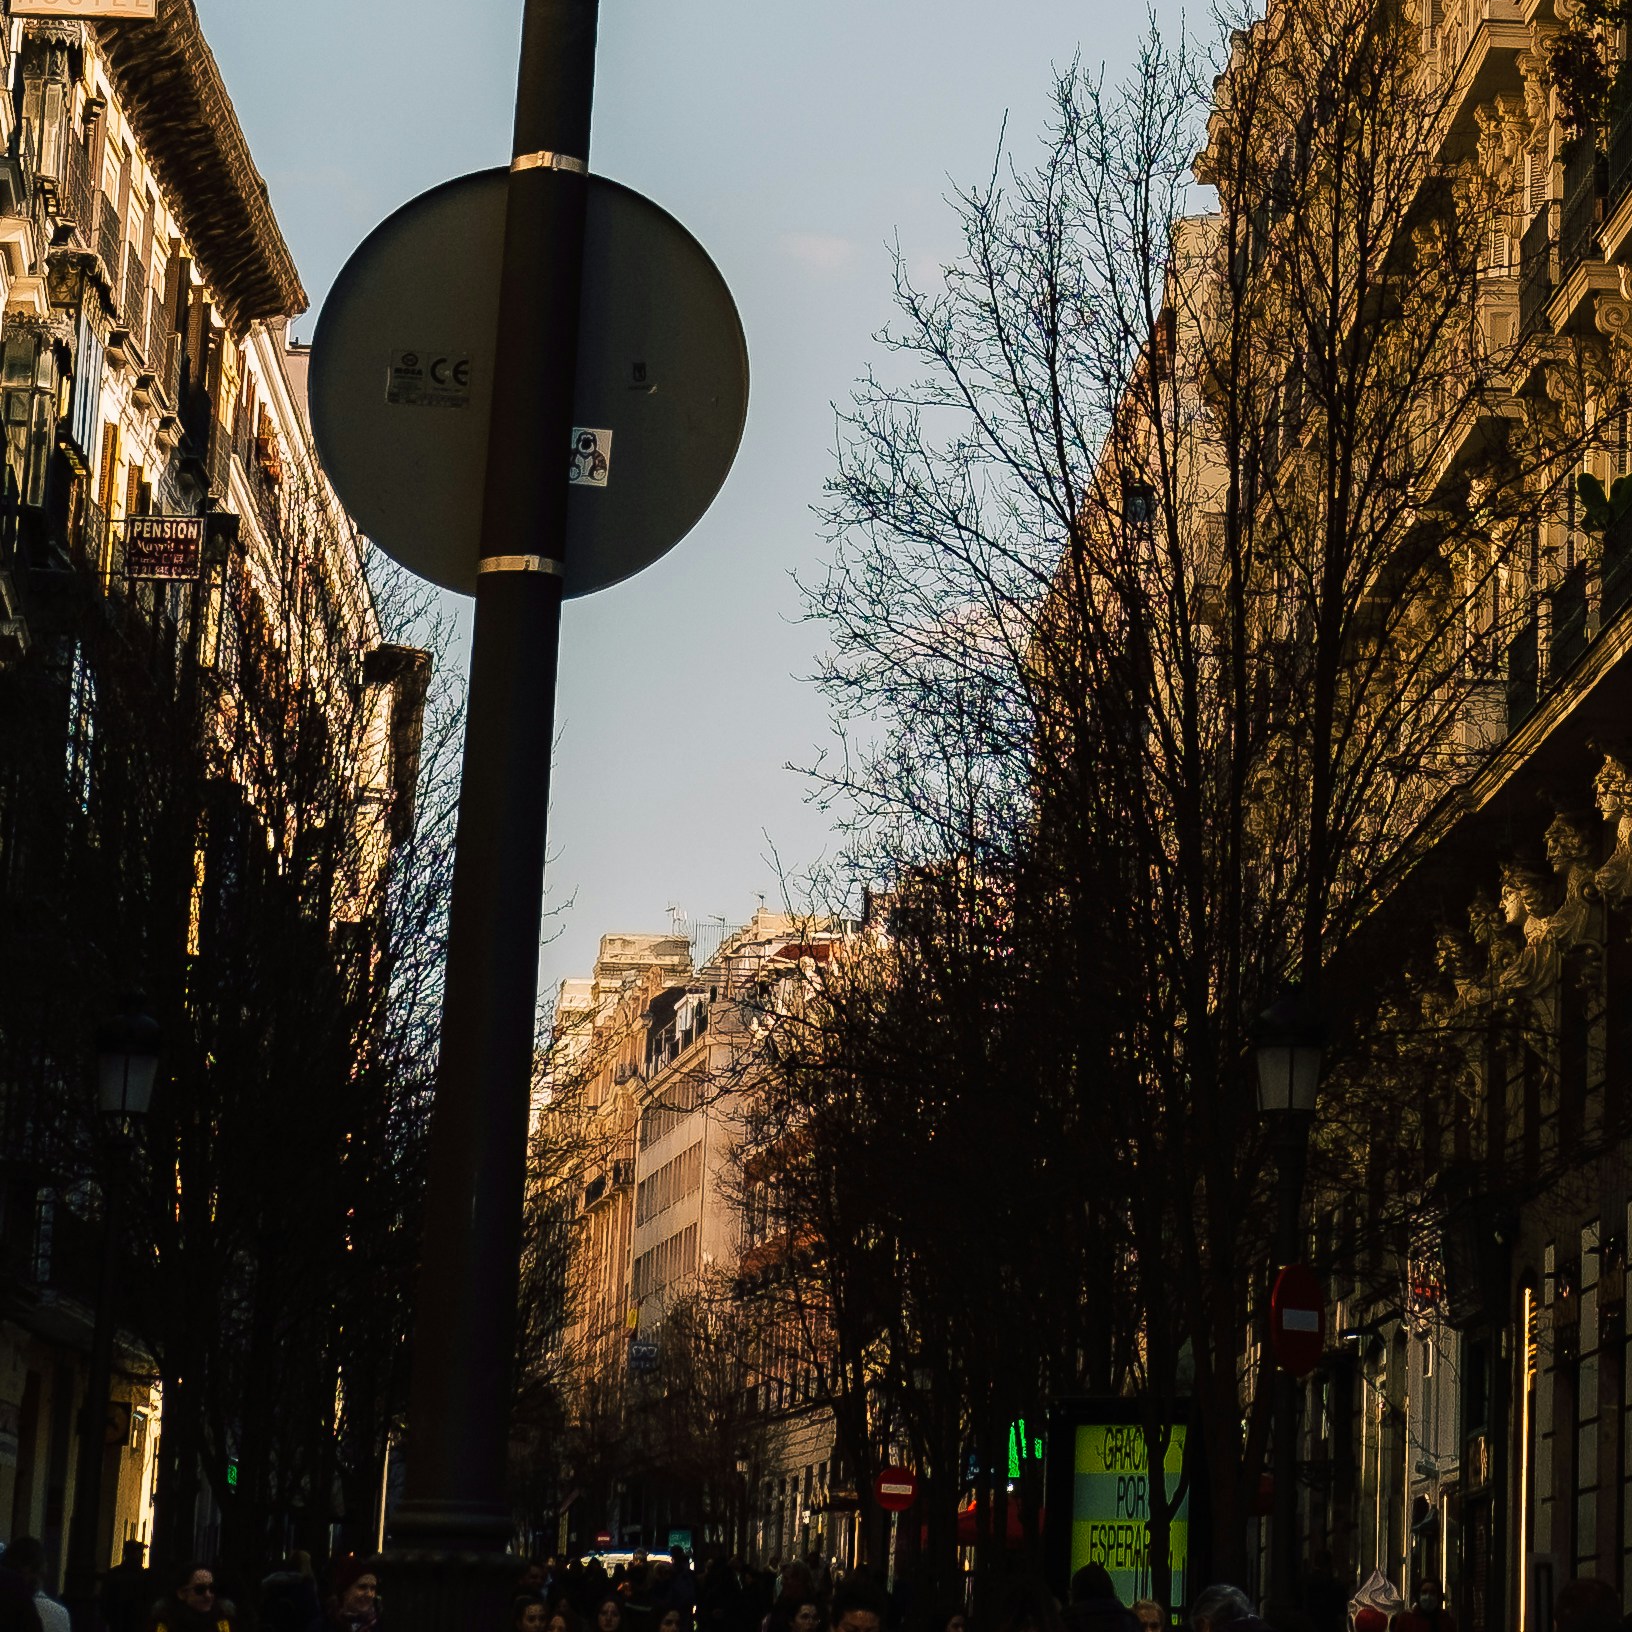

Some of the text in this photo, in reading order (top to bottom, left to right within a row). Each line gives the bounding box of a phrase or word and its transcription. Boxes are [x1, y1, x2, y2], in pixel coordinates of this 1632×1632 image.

[430, 357, 469, 386] CE
[133, 521, 198, 539] PENSION
[1103, 1426, 1150, 1471] GRACI
[1115, 1475, 1148, 1519] POR
[1089, 1524, 1152, 1567] ESPERAR
